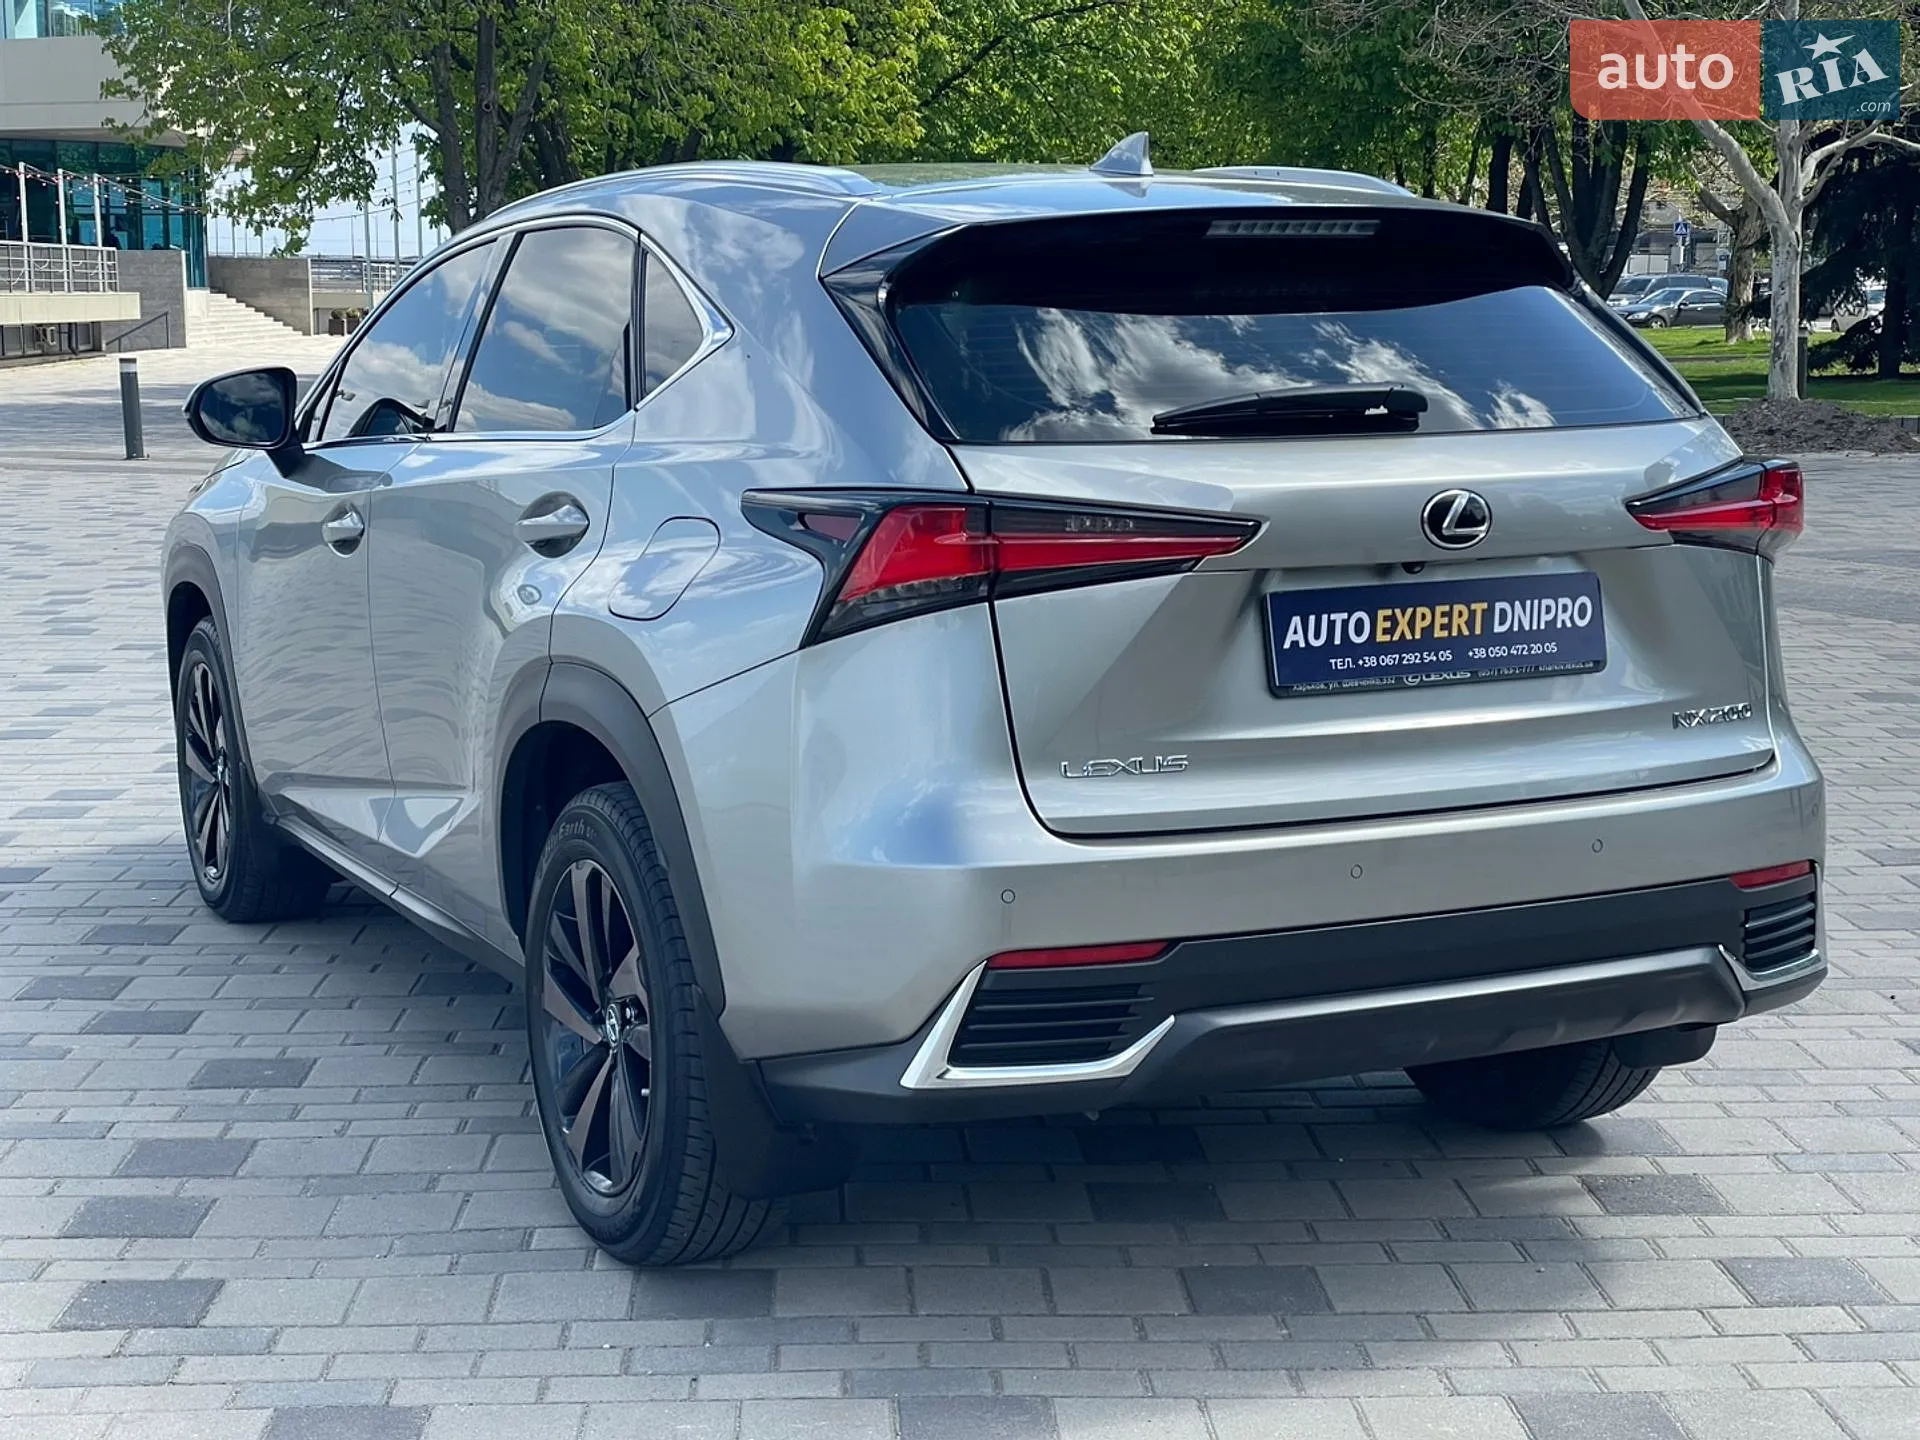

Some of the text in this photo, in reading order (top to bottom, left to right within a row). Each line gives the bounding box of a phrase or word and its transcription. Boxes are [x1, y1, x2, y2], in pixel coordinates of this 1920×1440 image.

[1283, 595, 1592, 649] AUTO EXPERT DNIPRO
[1358, 655, 1377, 668] +38
[1379, 653, 1400, 666] 067
[1402, 652, 1421, 665] 292
[1423, 651, 1436, 663] 54
[1438, 650, 1453, 662] 05
[1468, 641, 1558, 659] +38 050 472 20 05
[1060, 754, 1189, 779] LEXUS
